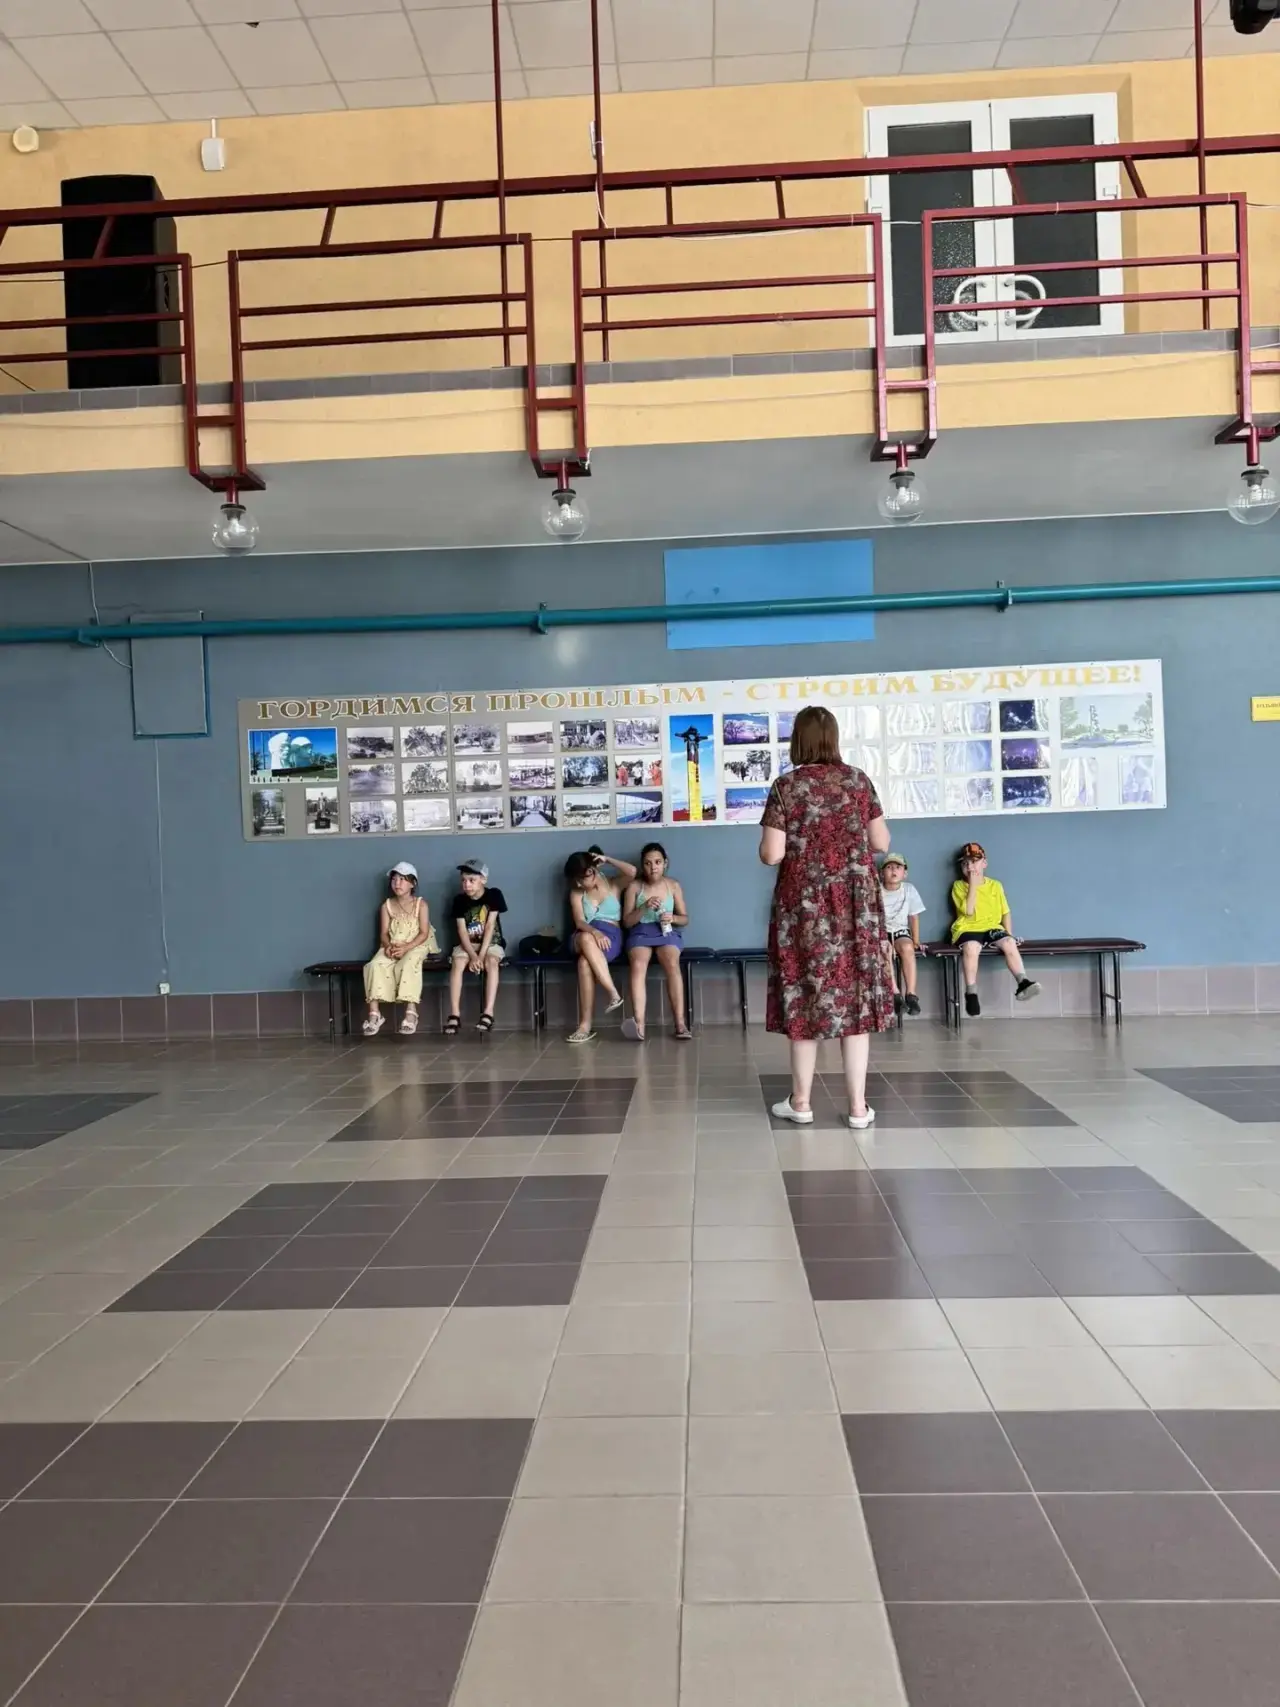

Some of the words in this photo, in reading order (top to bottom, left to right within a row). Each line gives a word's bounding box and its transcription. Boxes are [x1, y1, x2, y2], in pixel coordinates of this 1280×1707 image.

[257, 694, 476, 721] ГОРДИМСЯ
[486, 686, 706, 712] ПРОШЛЫМ
[746, 675, 918, 700] СТРОИМ
[931, 664, 1141, 693] БУДУЩЕЕ!
